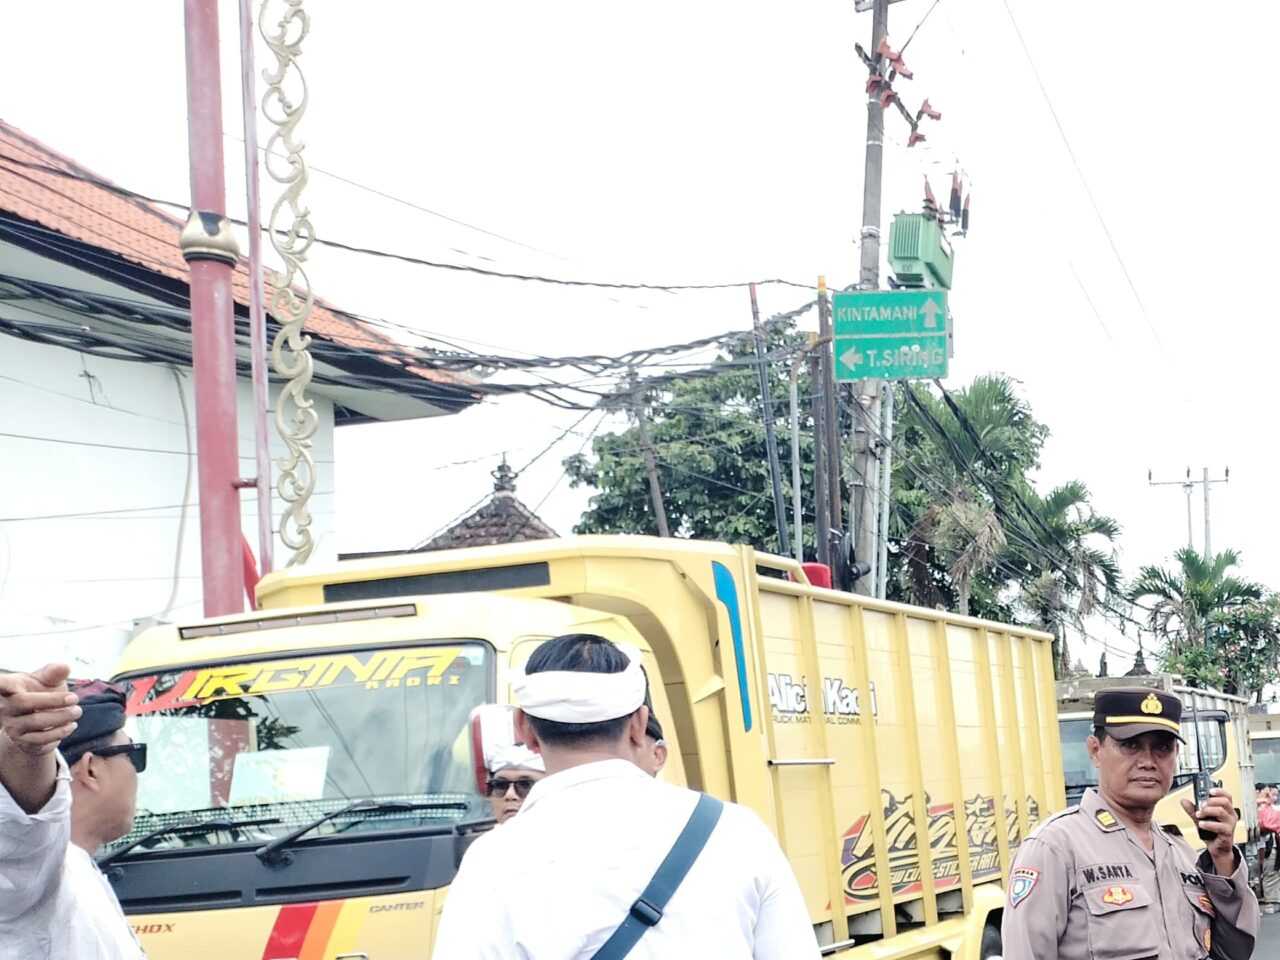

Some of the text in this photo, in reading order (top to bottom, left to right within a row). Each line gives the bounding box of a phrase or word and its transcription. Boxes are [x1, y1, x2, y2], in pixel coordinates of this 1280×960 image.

[837, 306, 917, 321] KINTAMANI
[370, 902, 424, 914] CANTER
[131, 922, 175, 935] HDX
